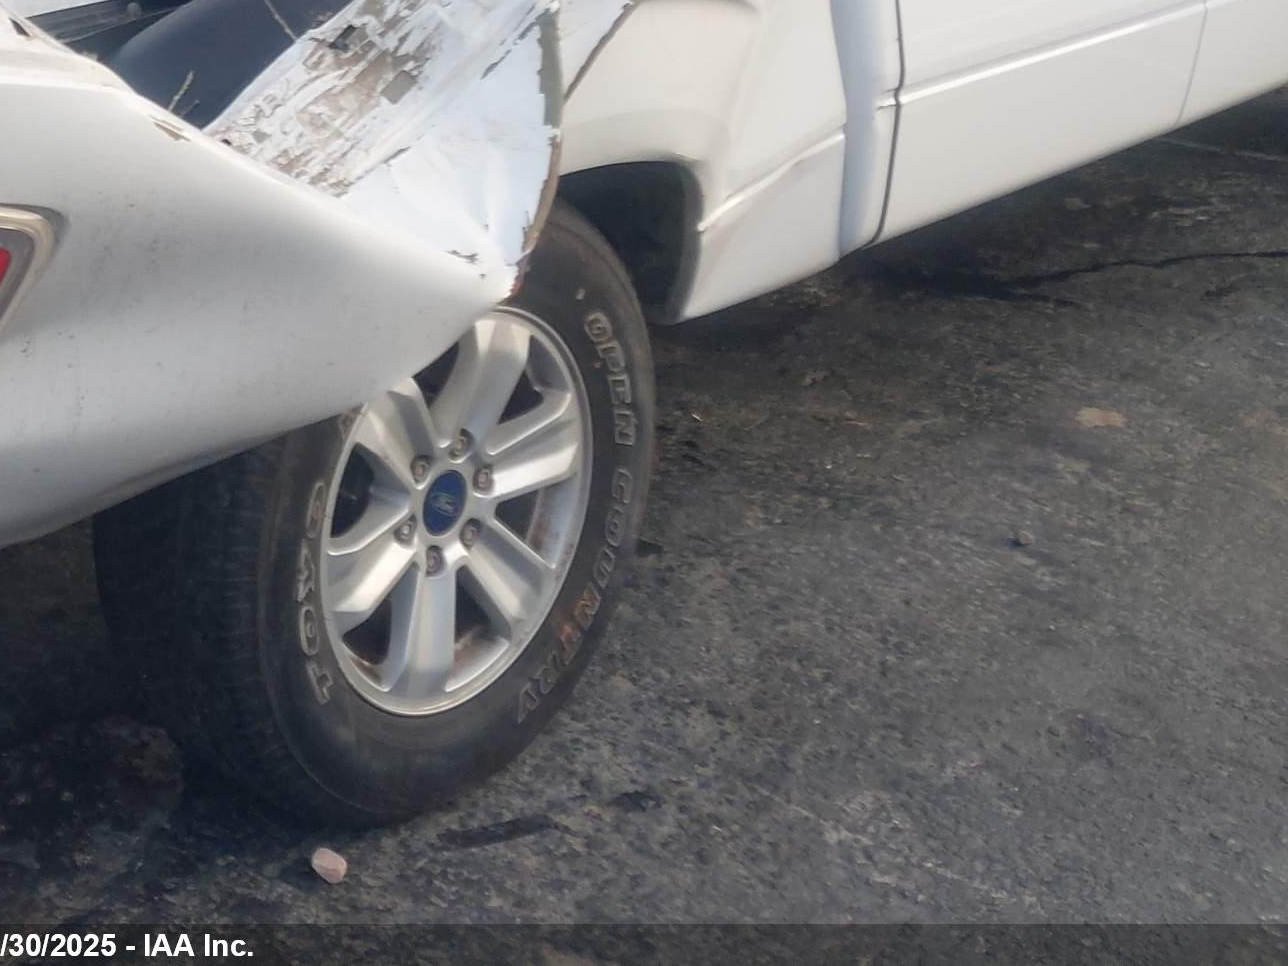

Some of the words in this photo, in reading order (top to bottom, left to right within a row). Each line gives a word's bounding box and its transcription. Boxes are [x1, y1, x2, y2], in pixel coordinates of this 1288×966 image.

[583, 311, 638, 448] OPEN
[293, 480, 334, 705] TOYO
[515, 467, 634, 726] COUNTRY
